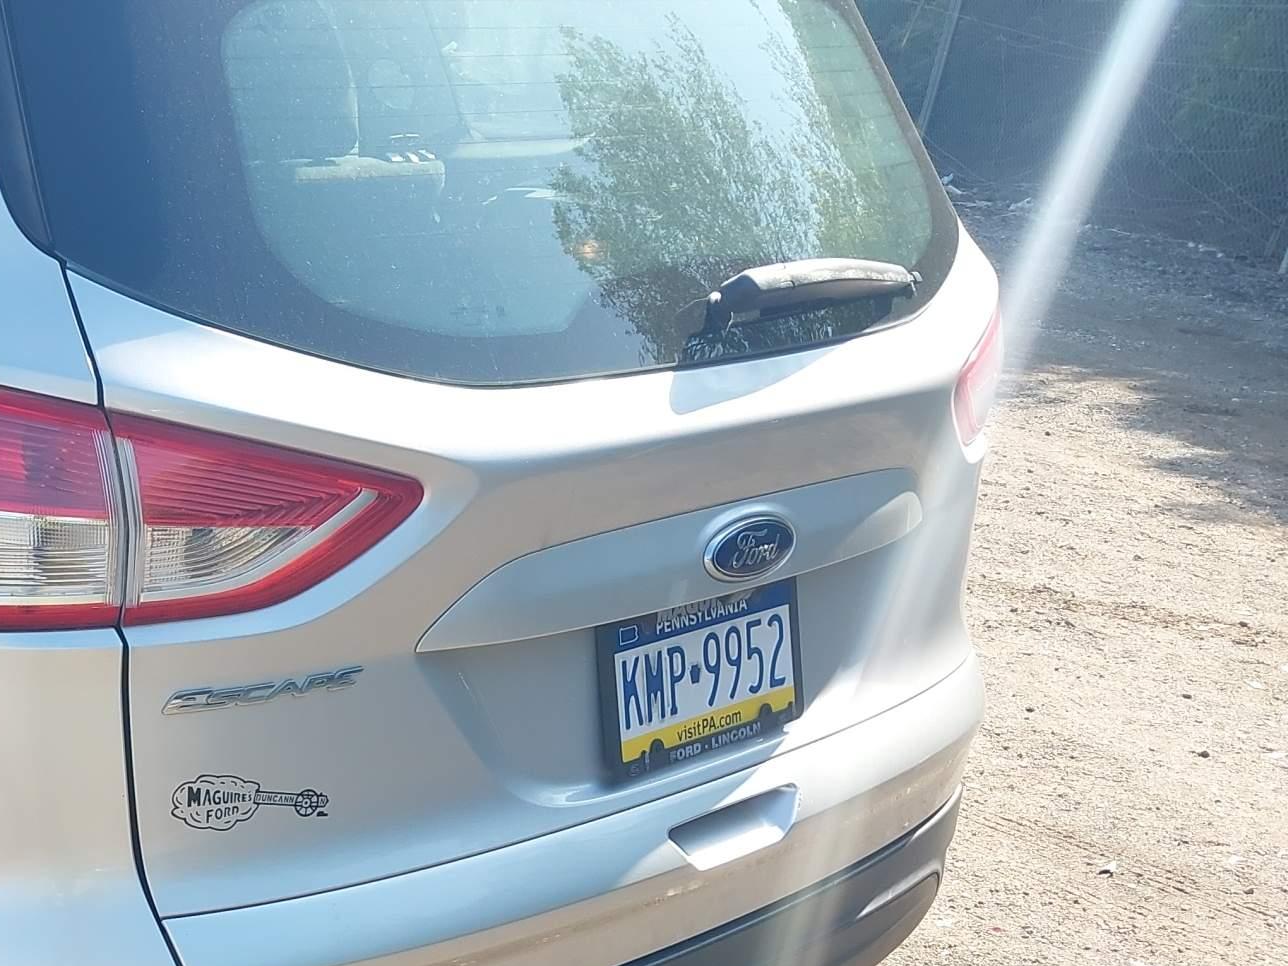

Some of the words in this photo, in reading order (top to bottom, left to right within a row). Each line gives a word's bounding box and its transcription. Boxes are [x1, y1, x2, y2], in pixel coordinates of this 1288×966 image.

[730, 529, 780, 568] Ford
[656, 599, 748, 635] PENNSYLVANIA
[162, 666, 364, 714] ESCAPE
[669, 746, 701, 762] FORD
[712, 722, 761, 748] LINCOLN
[677, 711, 742, 742] visitPA.com
[206, 805, 240, 824] FORD
